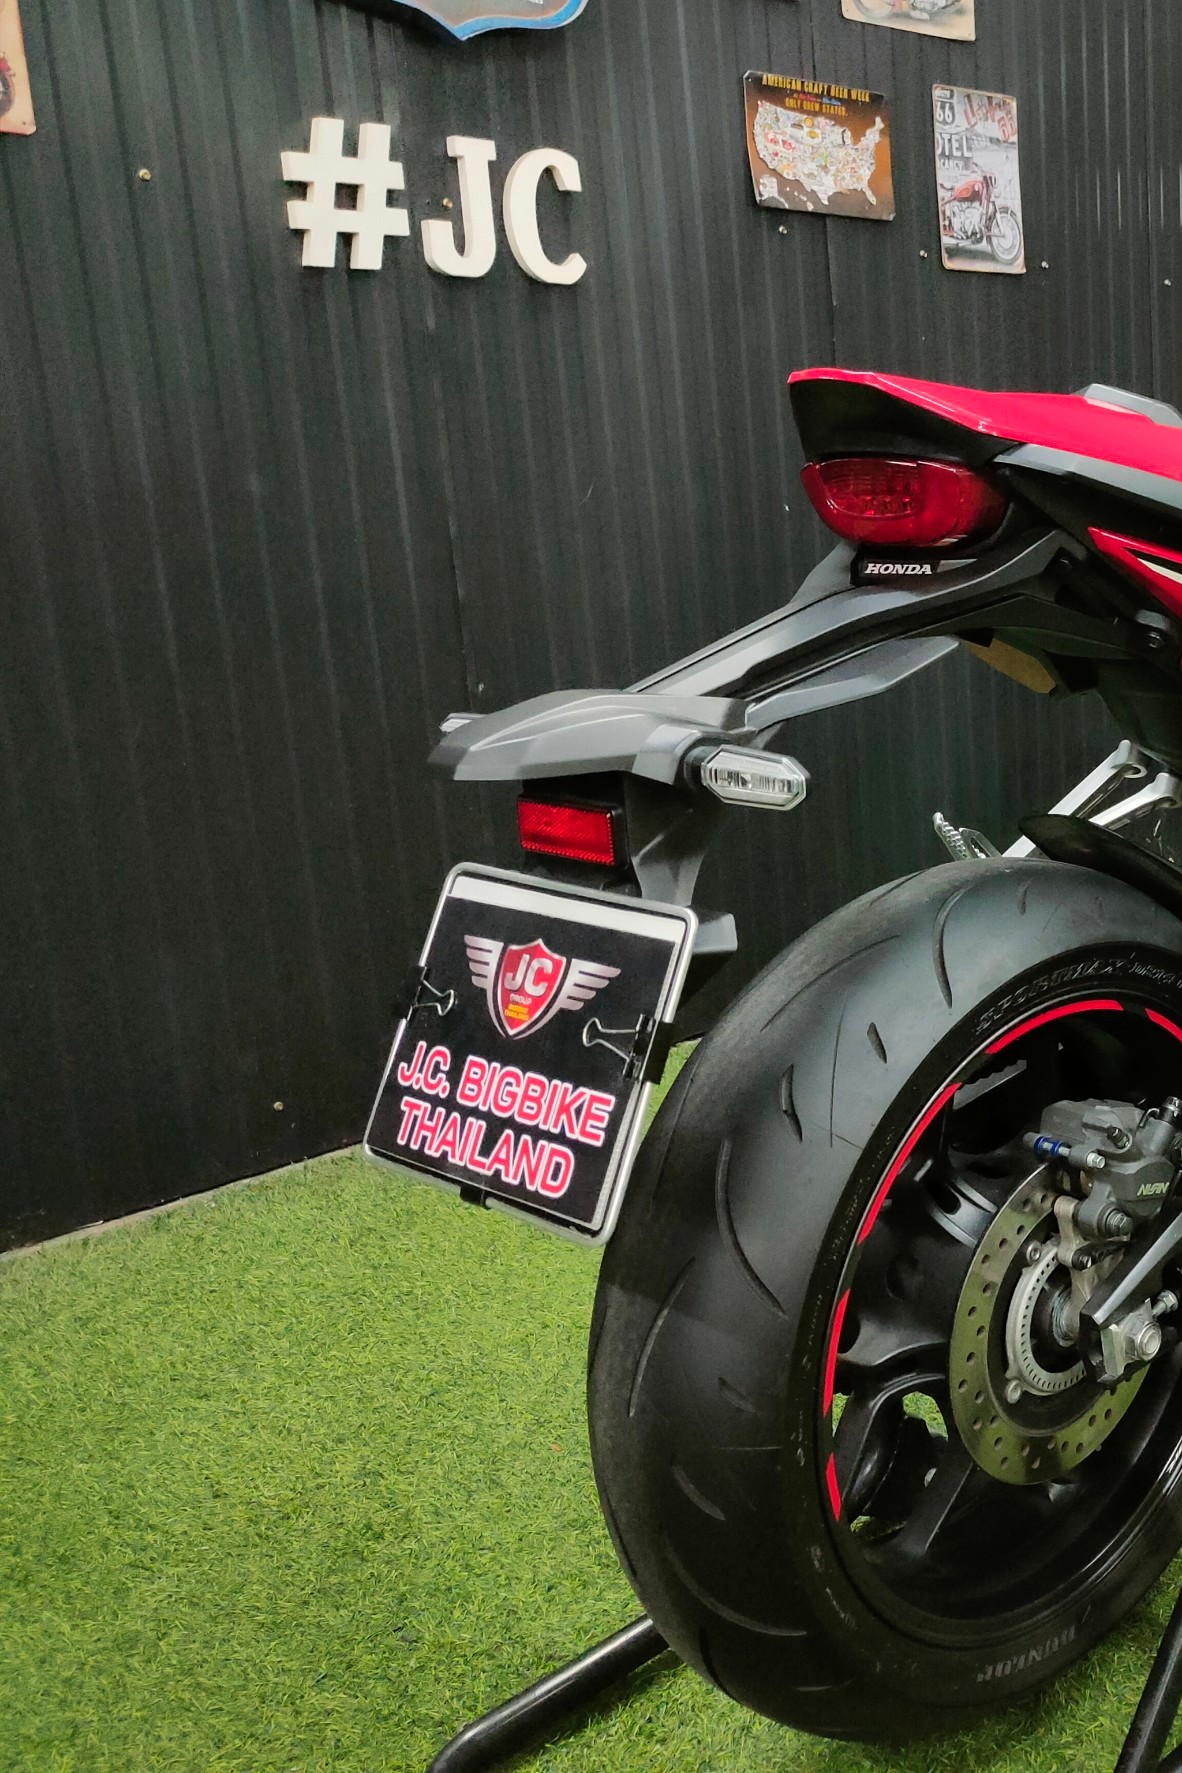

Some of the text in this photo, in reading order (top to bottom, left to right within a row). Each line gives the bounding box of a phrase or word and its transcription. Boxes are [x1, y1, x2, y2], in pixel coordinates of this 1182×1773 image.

[762, 73, 801, 91] AMERICAN
[804, 80, 828, 97] CRAFT
[936, 102, 954, 123] 66
[864, 563, 933, 575] HONDA
[504, 953, 553, 997] JC
[397, 1041, 616, 1147] J.C. BIGBIKE
[397, 1096, 575, 1198] THAILAND
